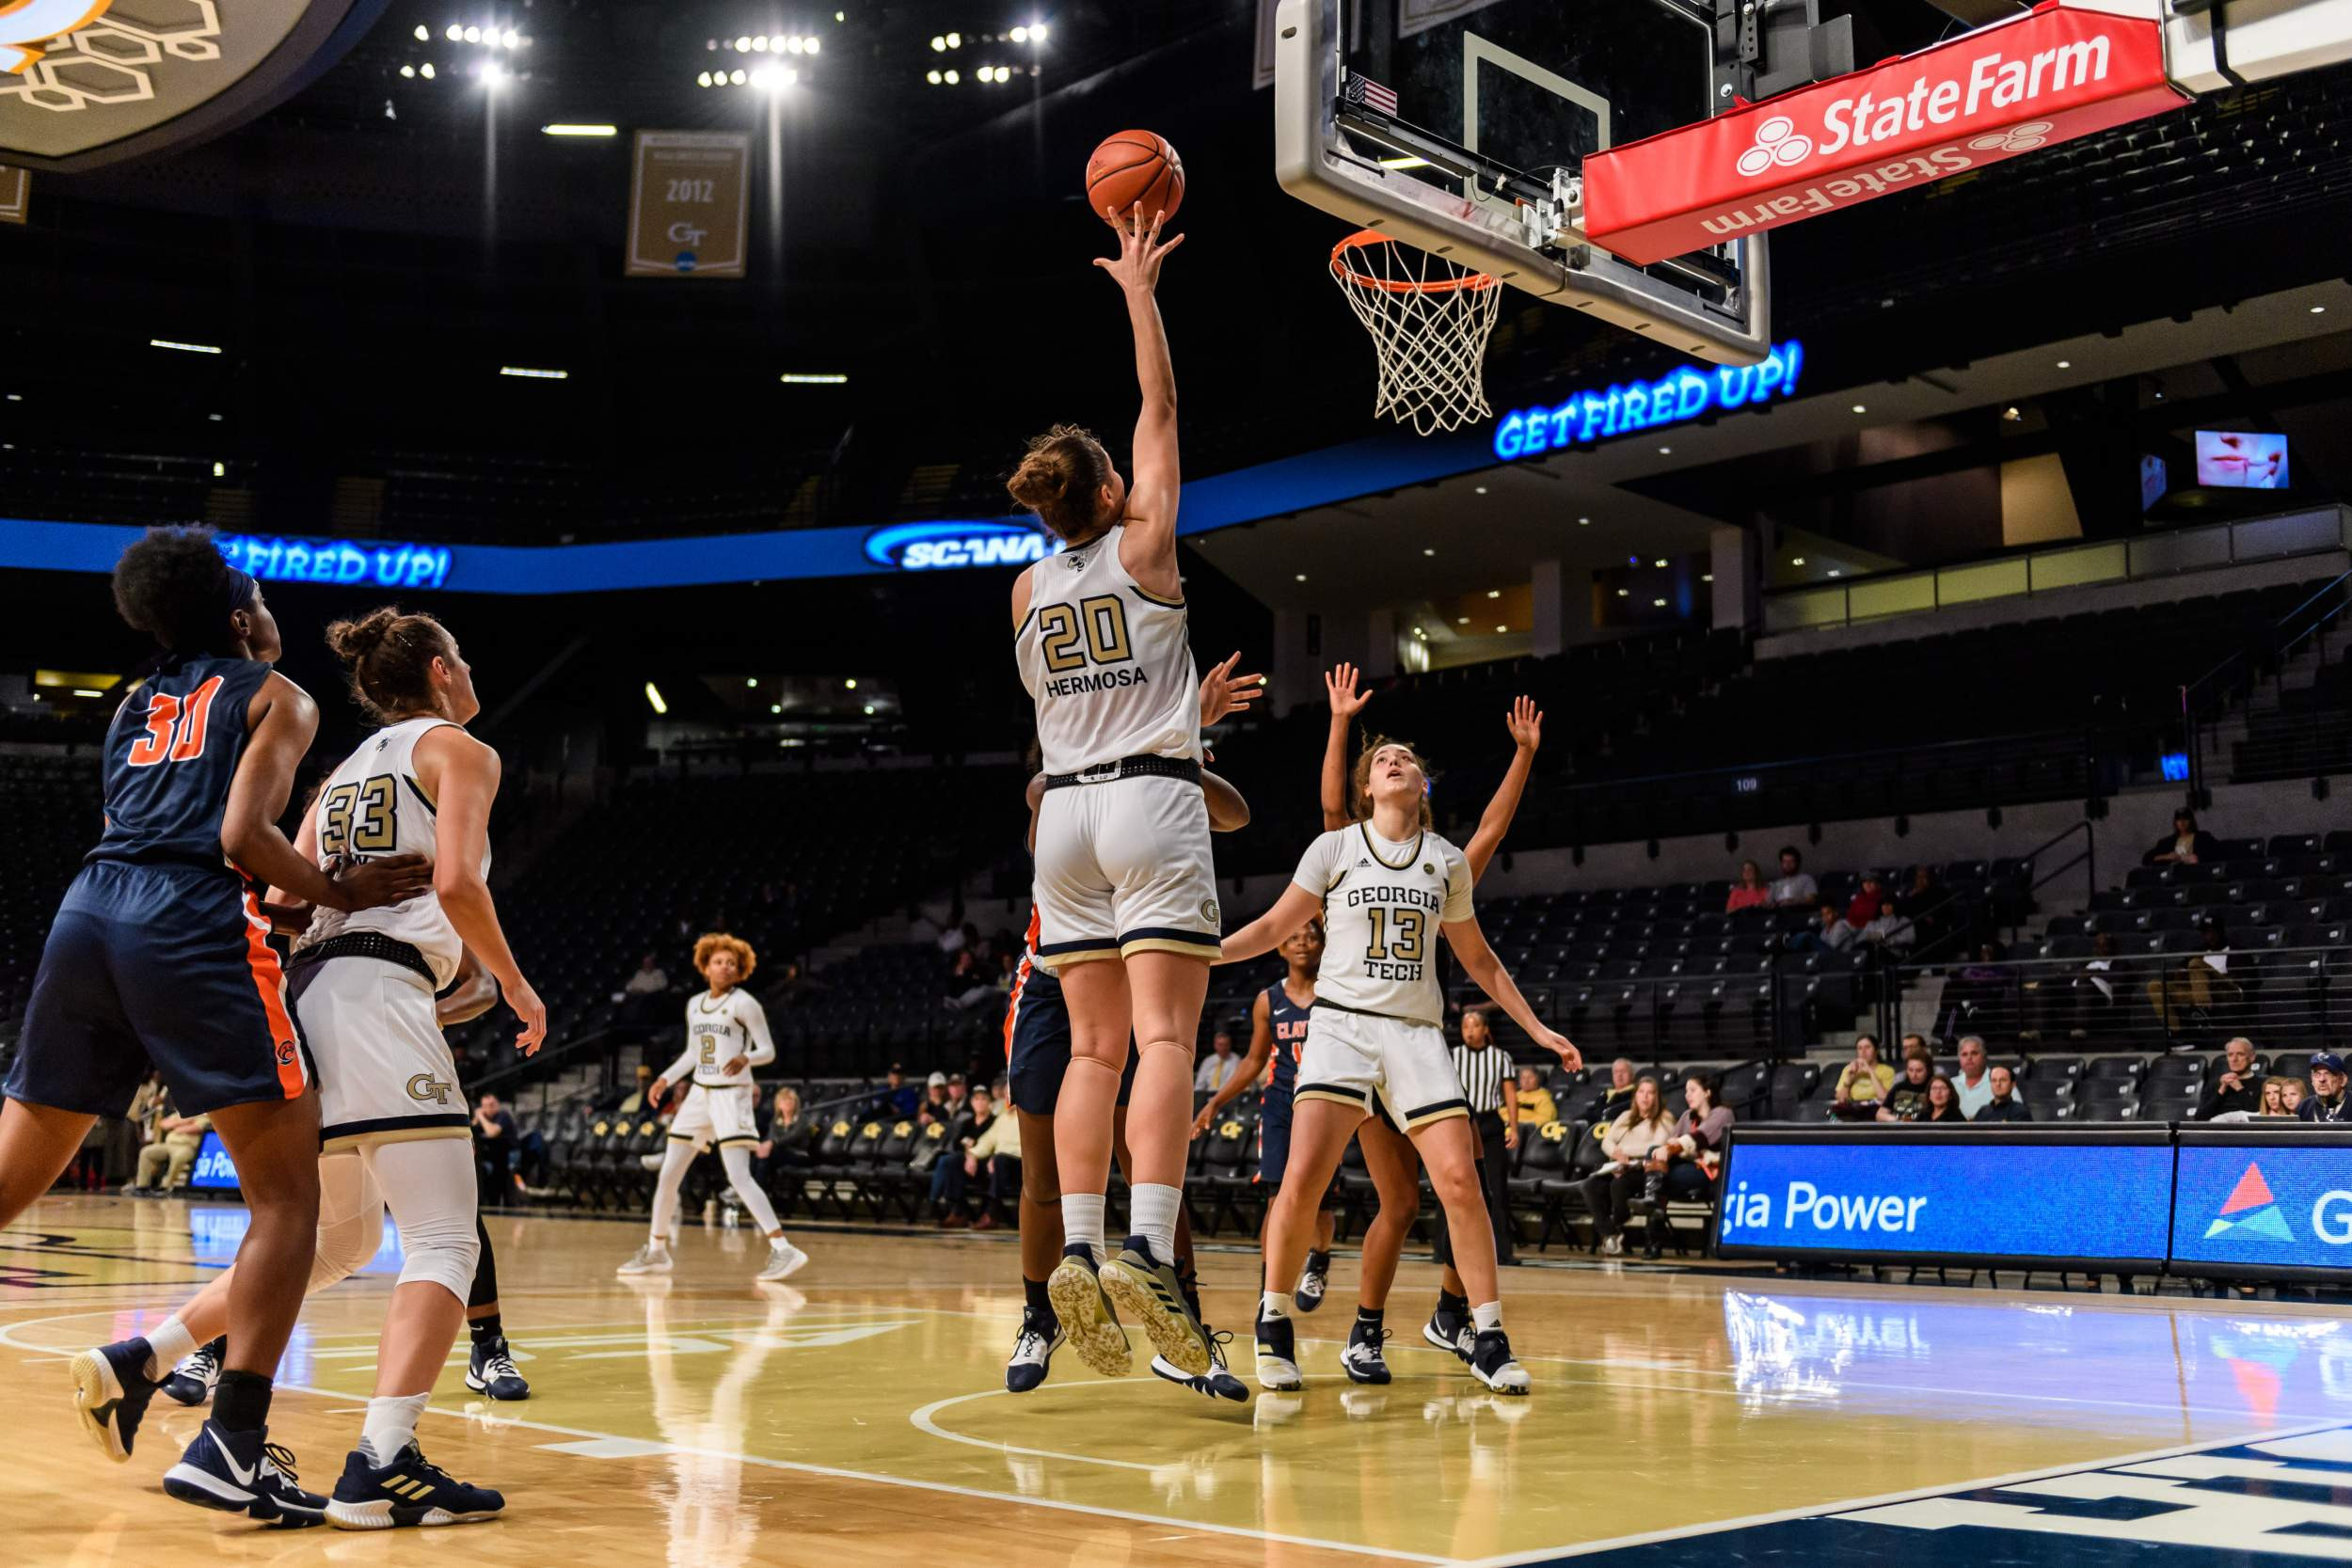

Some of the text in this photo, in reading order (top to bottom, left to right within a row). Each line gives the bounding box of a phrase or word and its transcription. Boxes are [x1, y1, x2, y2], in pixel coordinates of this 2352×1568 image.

[666, 179, 715, 202] 2012
[668, 222, 708, 247] GT
[1495, 347, 1797, 458] GET FIRED UP!
[243, 543, 368, 585] FIRED
[376, 551, 449, 588] UP!
[1039, 593, 1134, 673] 20
[1045, 666, 1148, 698] HERMOSA
[127, 674, 225, 768] 30
[322, 772, 398, 857] 33
[1347, 886, 1439, 914] GEORGIA
[1366, 906, 1426, 962] 13
[1363, 959, 1423, 981] TECH
[700, 1035, 717, 1065] 2
[405, 1072, 453, 1105] GT
[1784, 1180, 1929, 1233] Power
[2312, 1190, 2352, 1245] G
